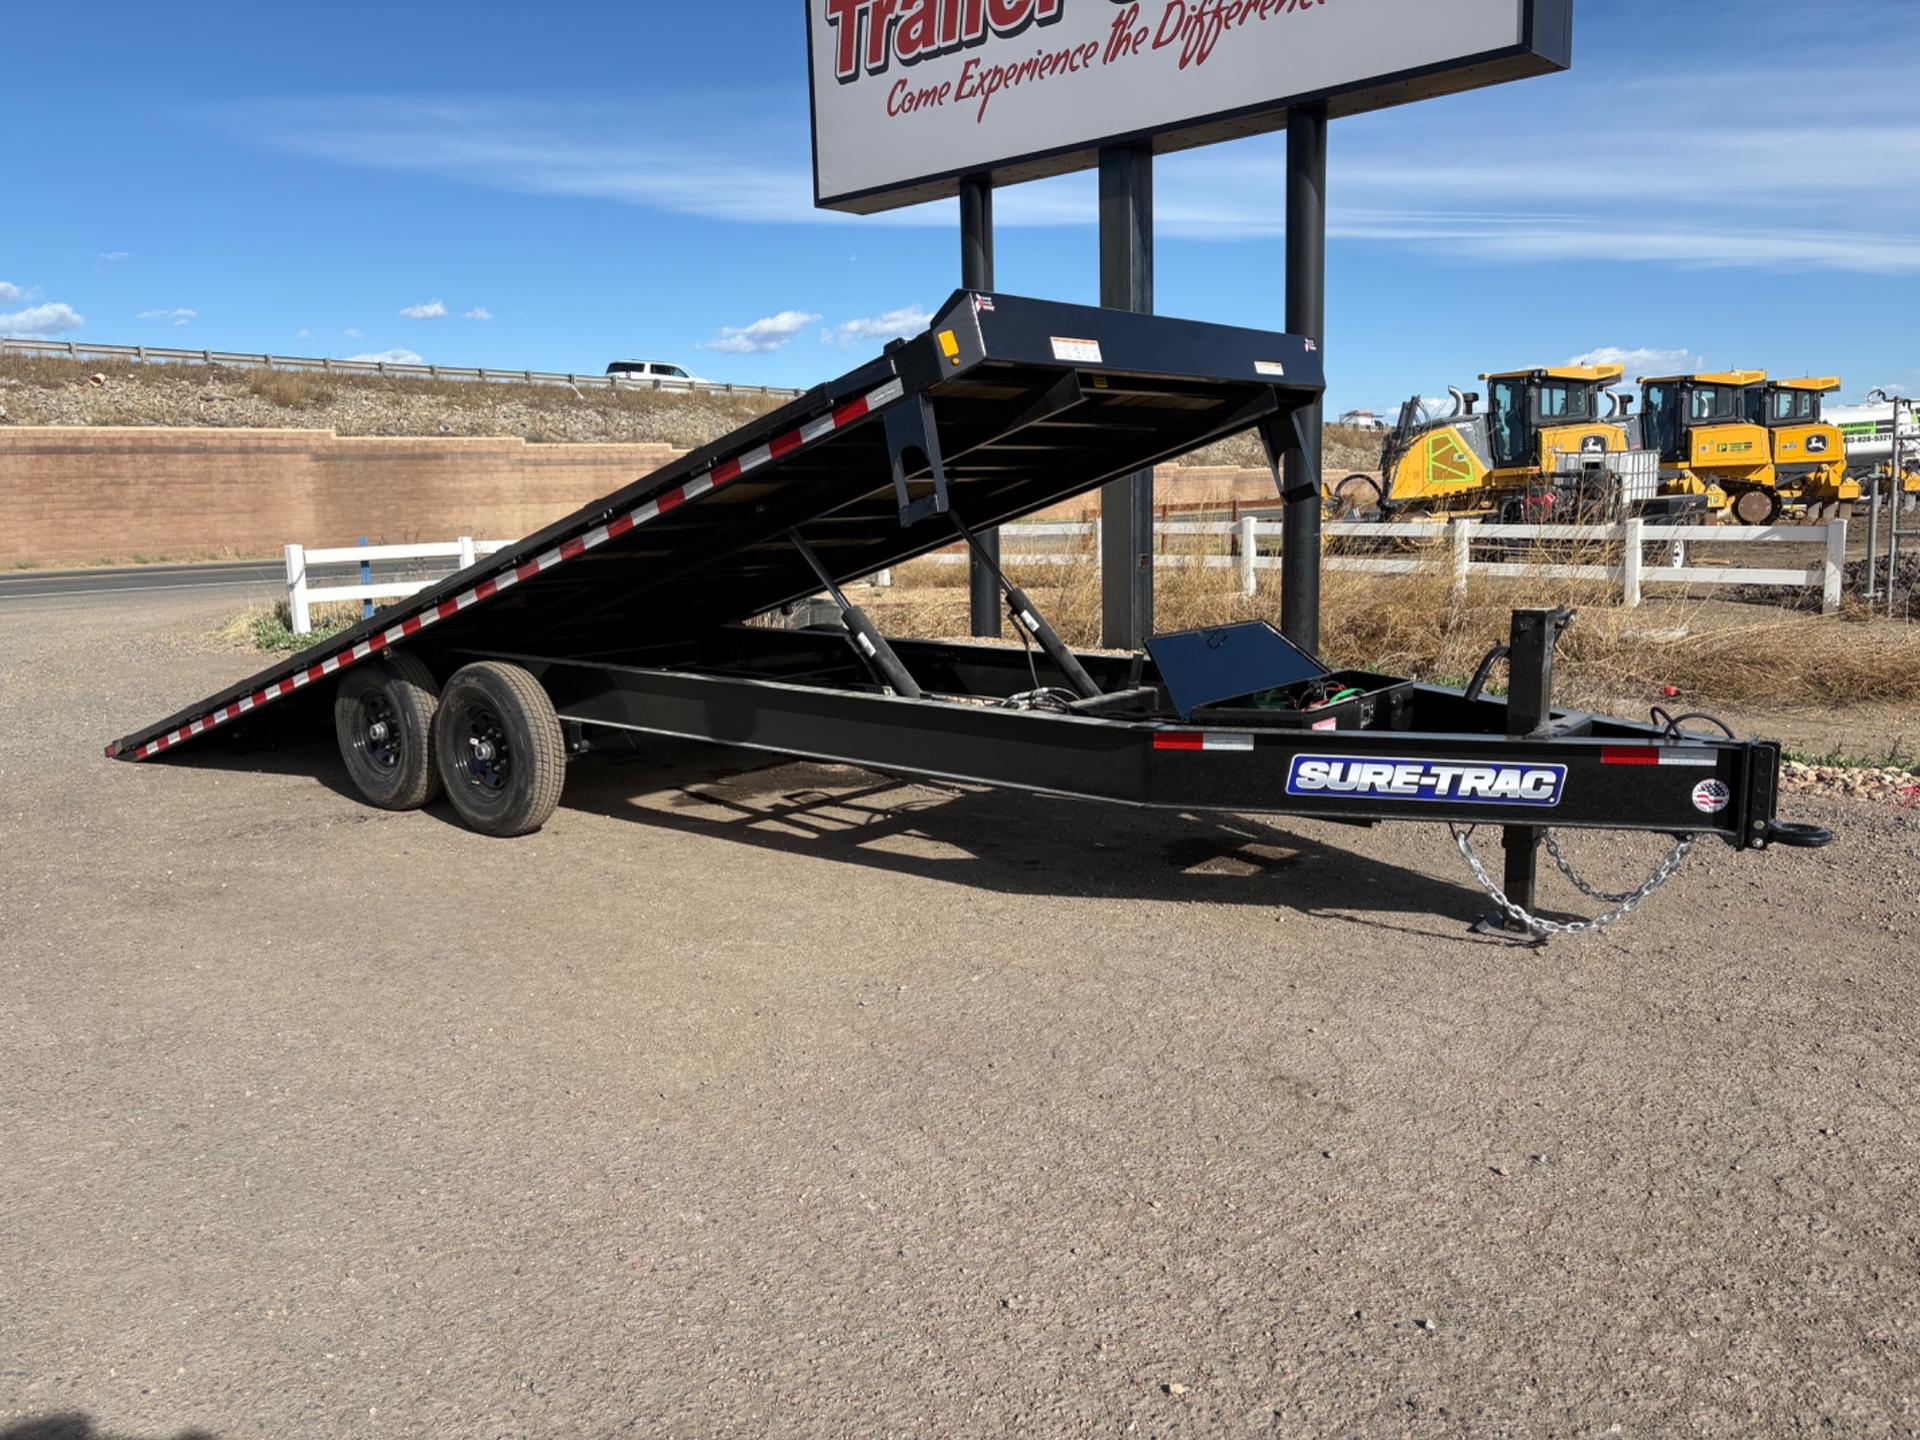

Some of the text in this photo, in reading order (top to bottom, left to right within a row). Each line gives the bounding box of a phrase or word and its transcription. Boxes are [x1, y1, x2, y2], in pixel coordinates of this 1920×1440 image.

[825, 0, 1064, 85] Trai
[887, 0, 1326, 123] Come Experience the Differen
[1295, 760, 1556, 800] SURE-TRAC
